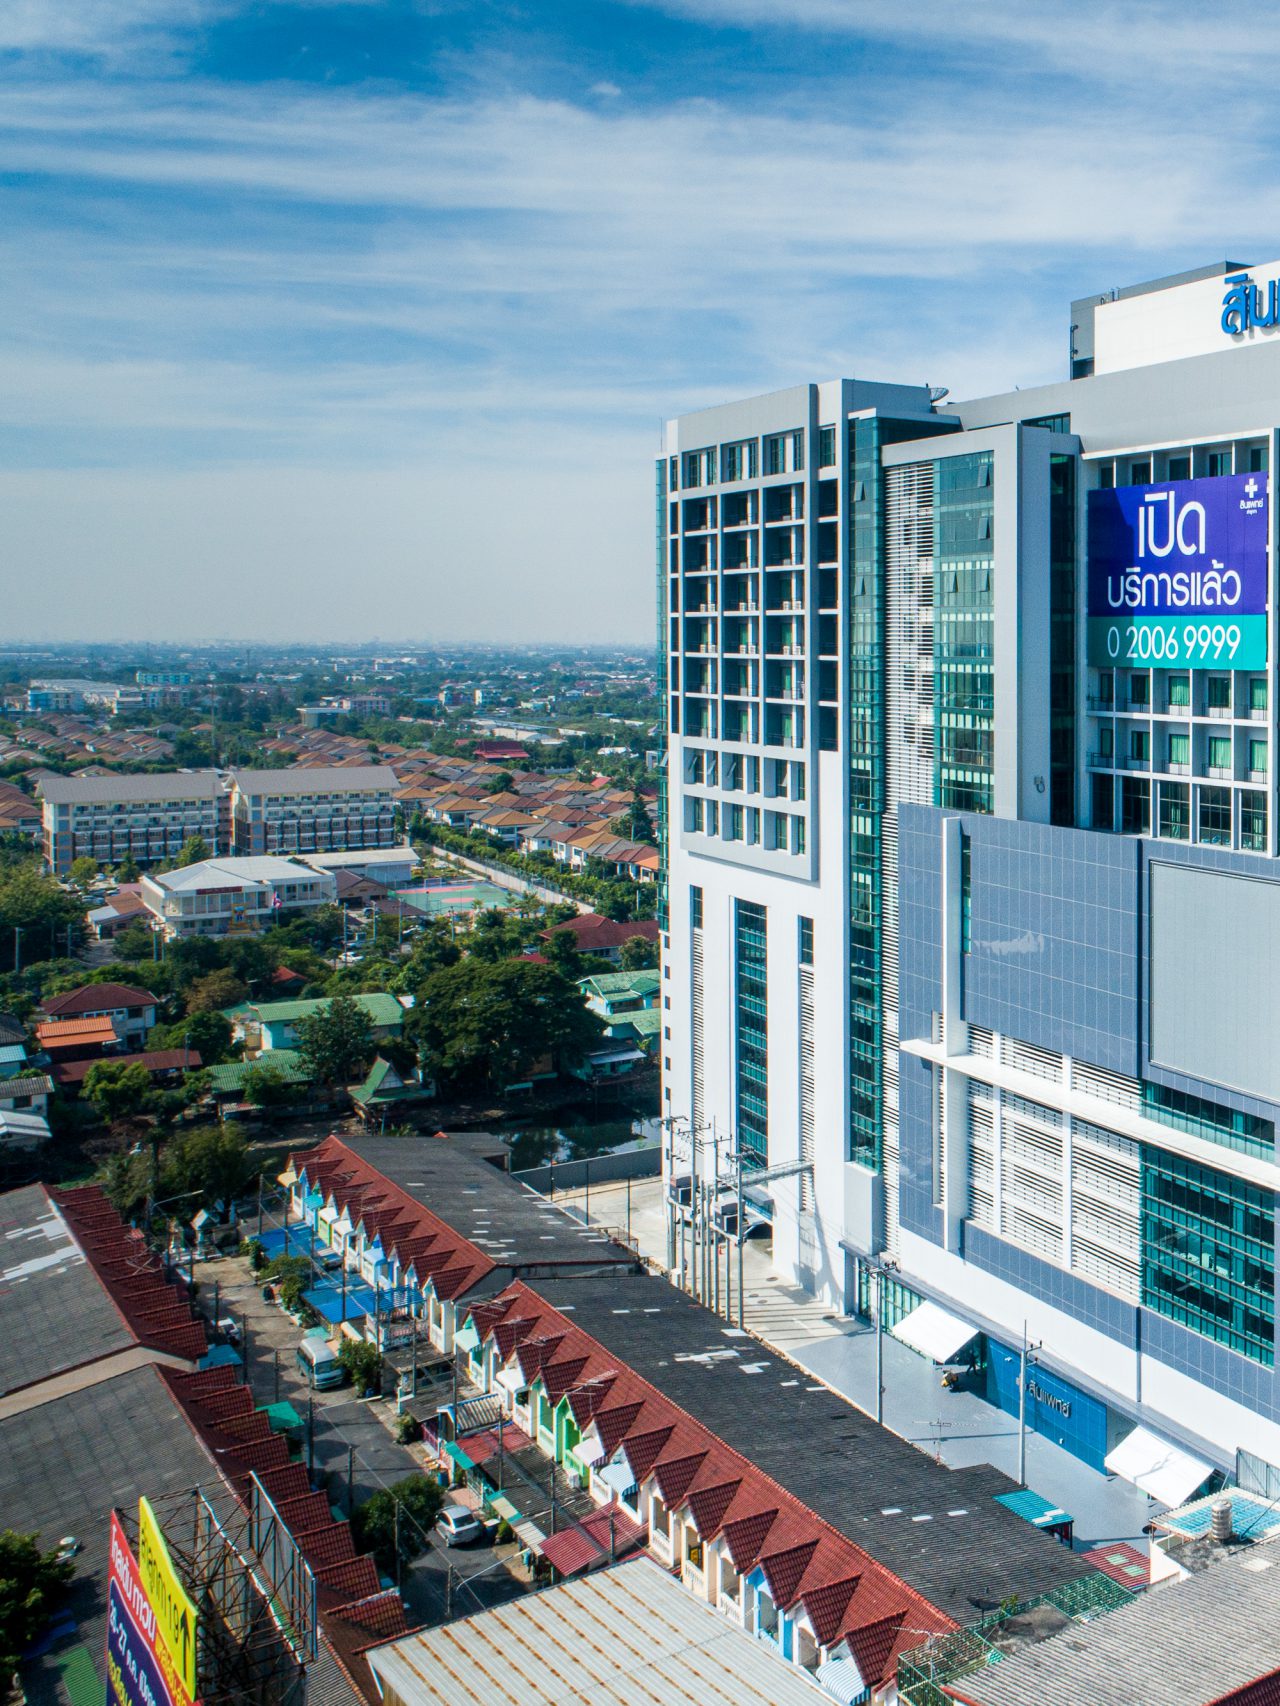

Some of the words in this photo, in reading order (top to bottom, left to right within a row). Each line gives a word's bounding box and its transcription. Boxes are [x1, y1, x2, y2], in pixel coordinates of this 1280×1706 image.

[1138, 490, 1206, 558] เปิด
[1107, 559, 1242, 608] บริการแล้ว
[1107, 626, 1120, 658] 0
[1126, 625, 1179, 660] 2006
[1183, 624, 1241, 660] 9999
